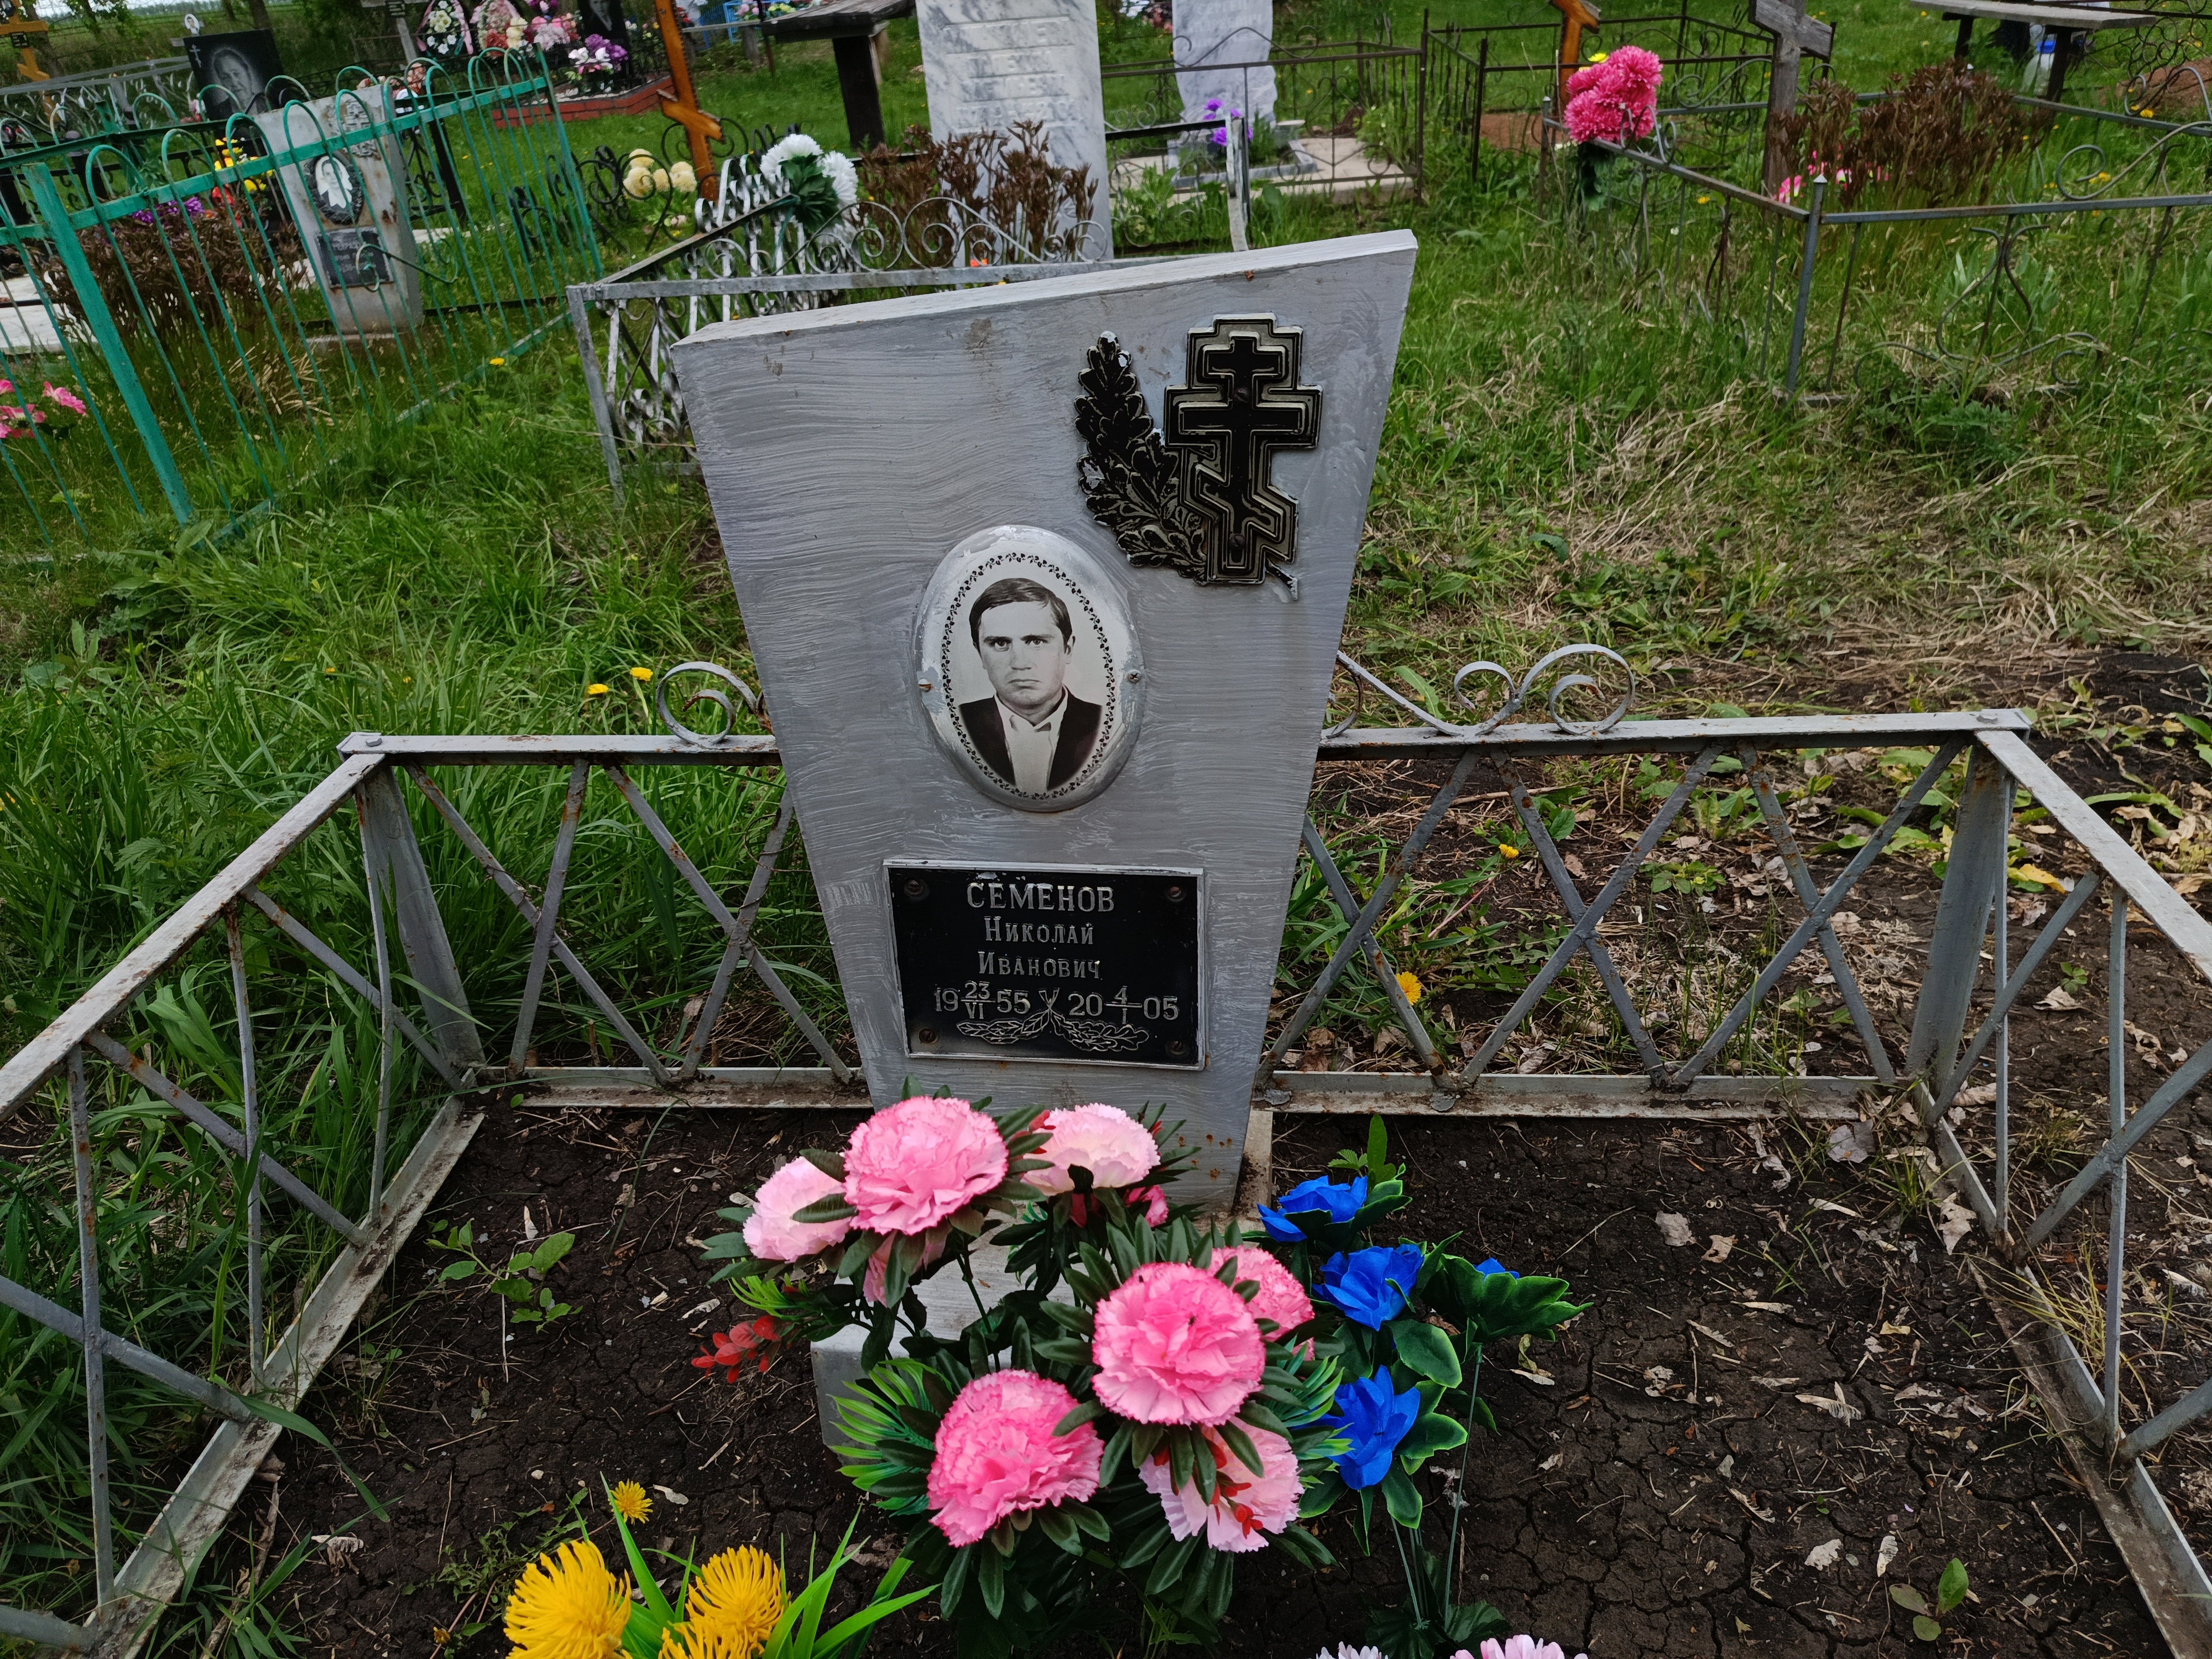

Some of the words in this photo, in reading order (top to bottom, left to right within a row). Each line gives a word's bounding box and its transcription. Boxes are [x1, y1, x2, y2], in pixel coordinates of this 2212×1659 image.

[967, 883, 1114, 912] СЕМЕНОВ
[935, 987, 958, 1011] 19
[964, 980, 990, 1000] 23
[997, 989, 1031, 1014] 55
[1068, 993, 1104, 1016] 20
[1144, 996, 1180, 1020] 05
